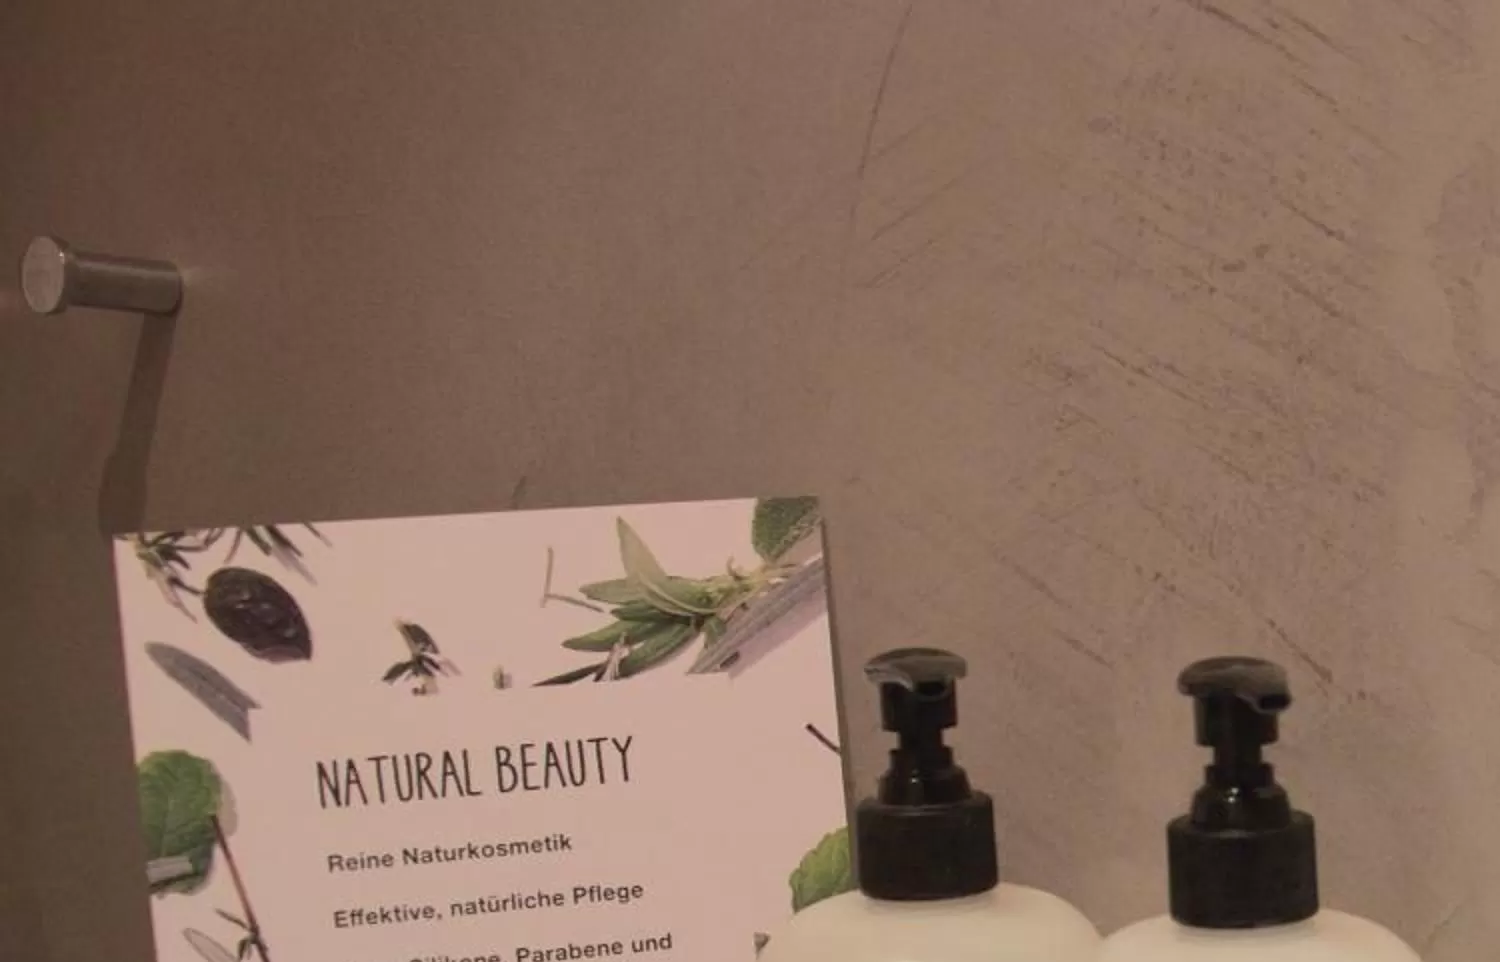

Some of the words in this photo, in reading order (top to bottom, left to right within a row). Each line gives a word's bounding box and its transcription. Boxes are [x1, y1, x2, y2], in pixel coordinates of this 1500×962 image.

[315, 748, 482, 810] NATURAL
[494, 736, 633, 793] BEAUTY
[327, 852, 395, 874] Reine
[402, 832, 573, 866] Naturkosmetik
[333, 903, 443, 930] Effektive,
[450, 889, 566, 917] natürliche
[572, 883, 645, 906] Pflege
[631, 932, 673, 953] und
